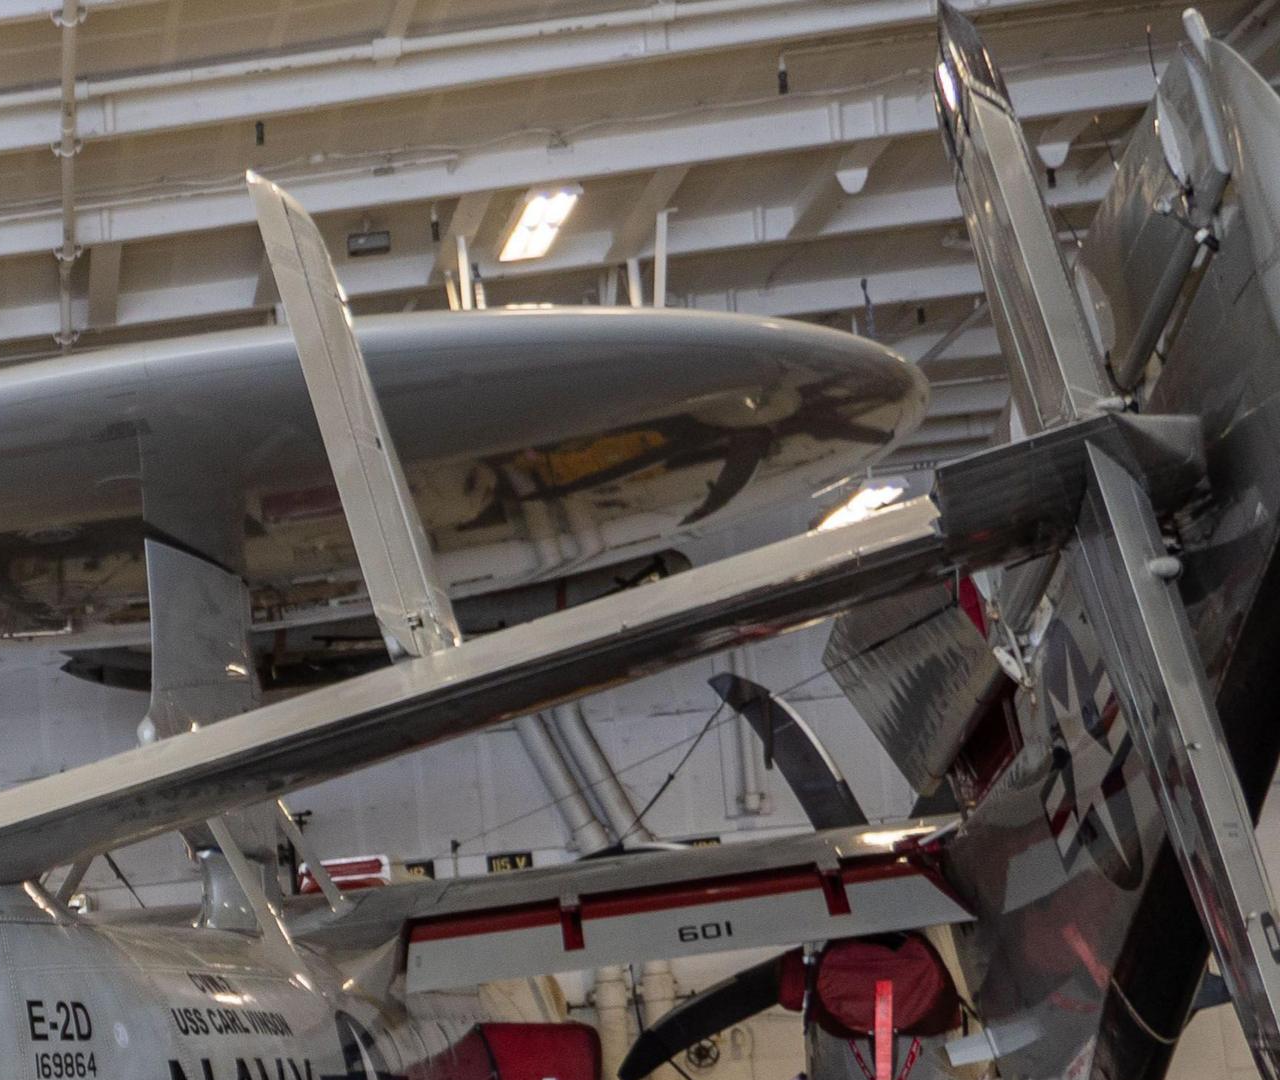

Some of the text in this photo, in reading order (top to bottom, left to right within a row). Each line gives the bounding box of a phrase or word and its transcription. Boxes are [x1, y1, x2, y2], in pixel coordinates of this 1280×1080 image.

[678, 920, 733, 943] 601
[26, 1000, 93, 1041] E-2D
[171, 1008, 294, 1036] USS CARL VINSON
[36, 1052, 97, 1079] 169864
